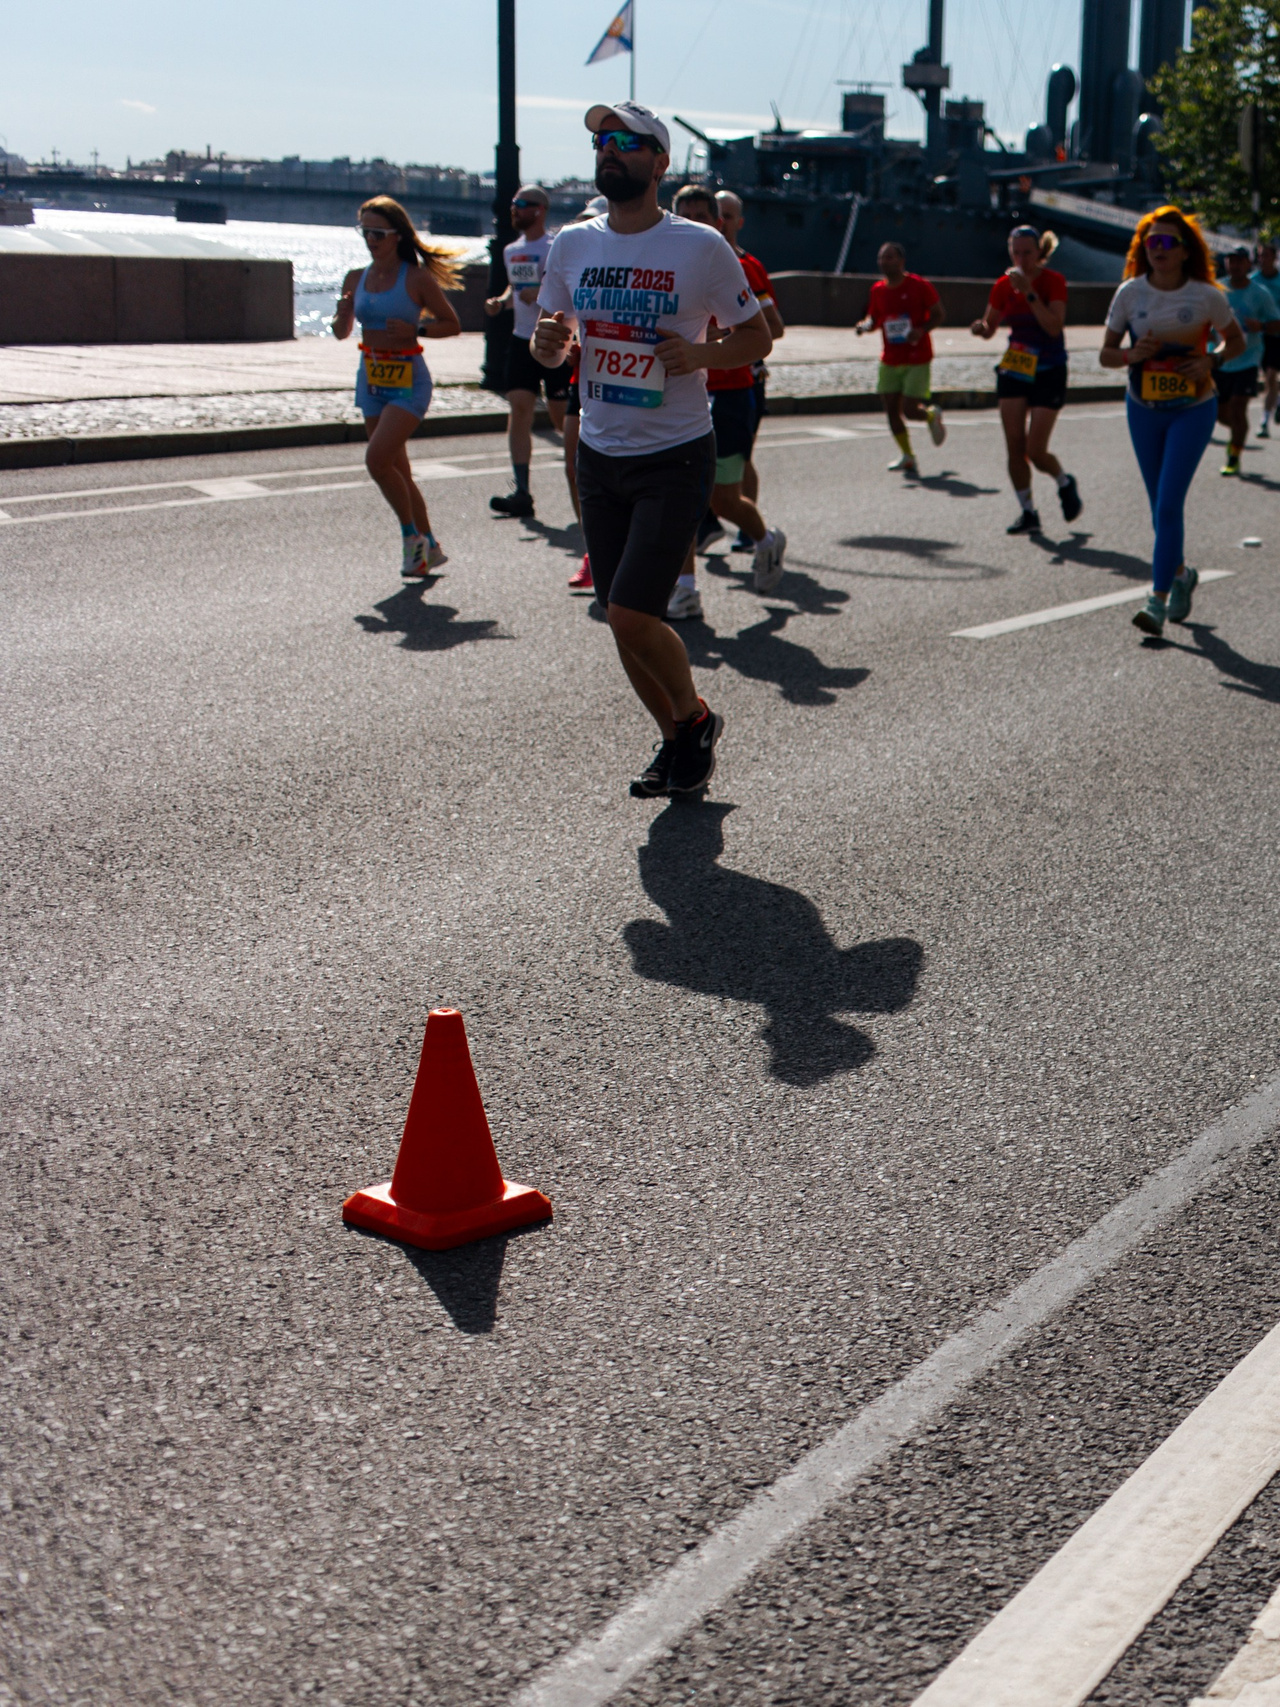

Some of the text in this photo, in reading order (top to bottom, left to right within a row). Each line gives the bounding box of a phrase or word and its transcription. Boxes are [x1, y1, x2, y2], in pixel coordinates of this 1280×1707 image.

[579, 267, 676, 293] #ЗАБЕГ2025
[600, 288, 679, 316] ПЛАНЕТЫ
[369, 363, 406, 380] 2377
[594, 348, 655, 379] 7827
[1150, 375, 1188, 392] 1886
